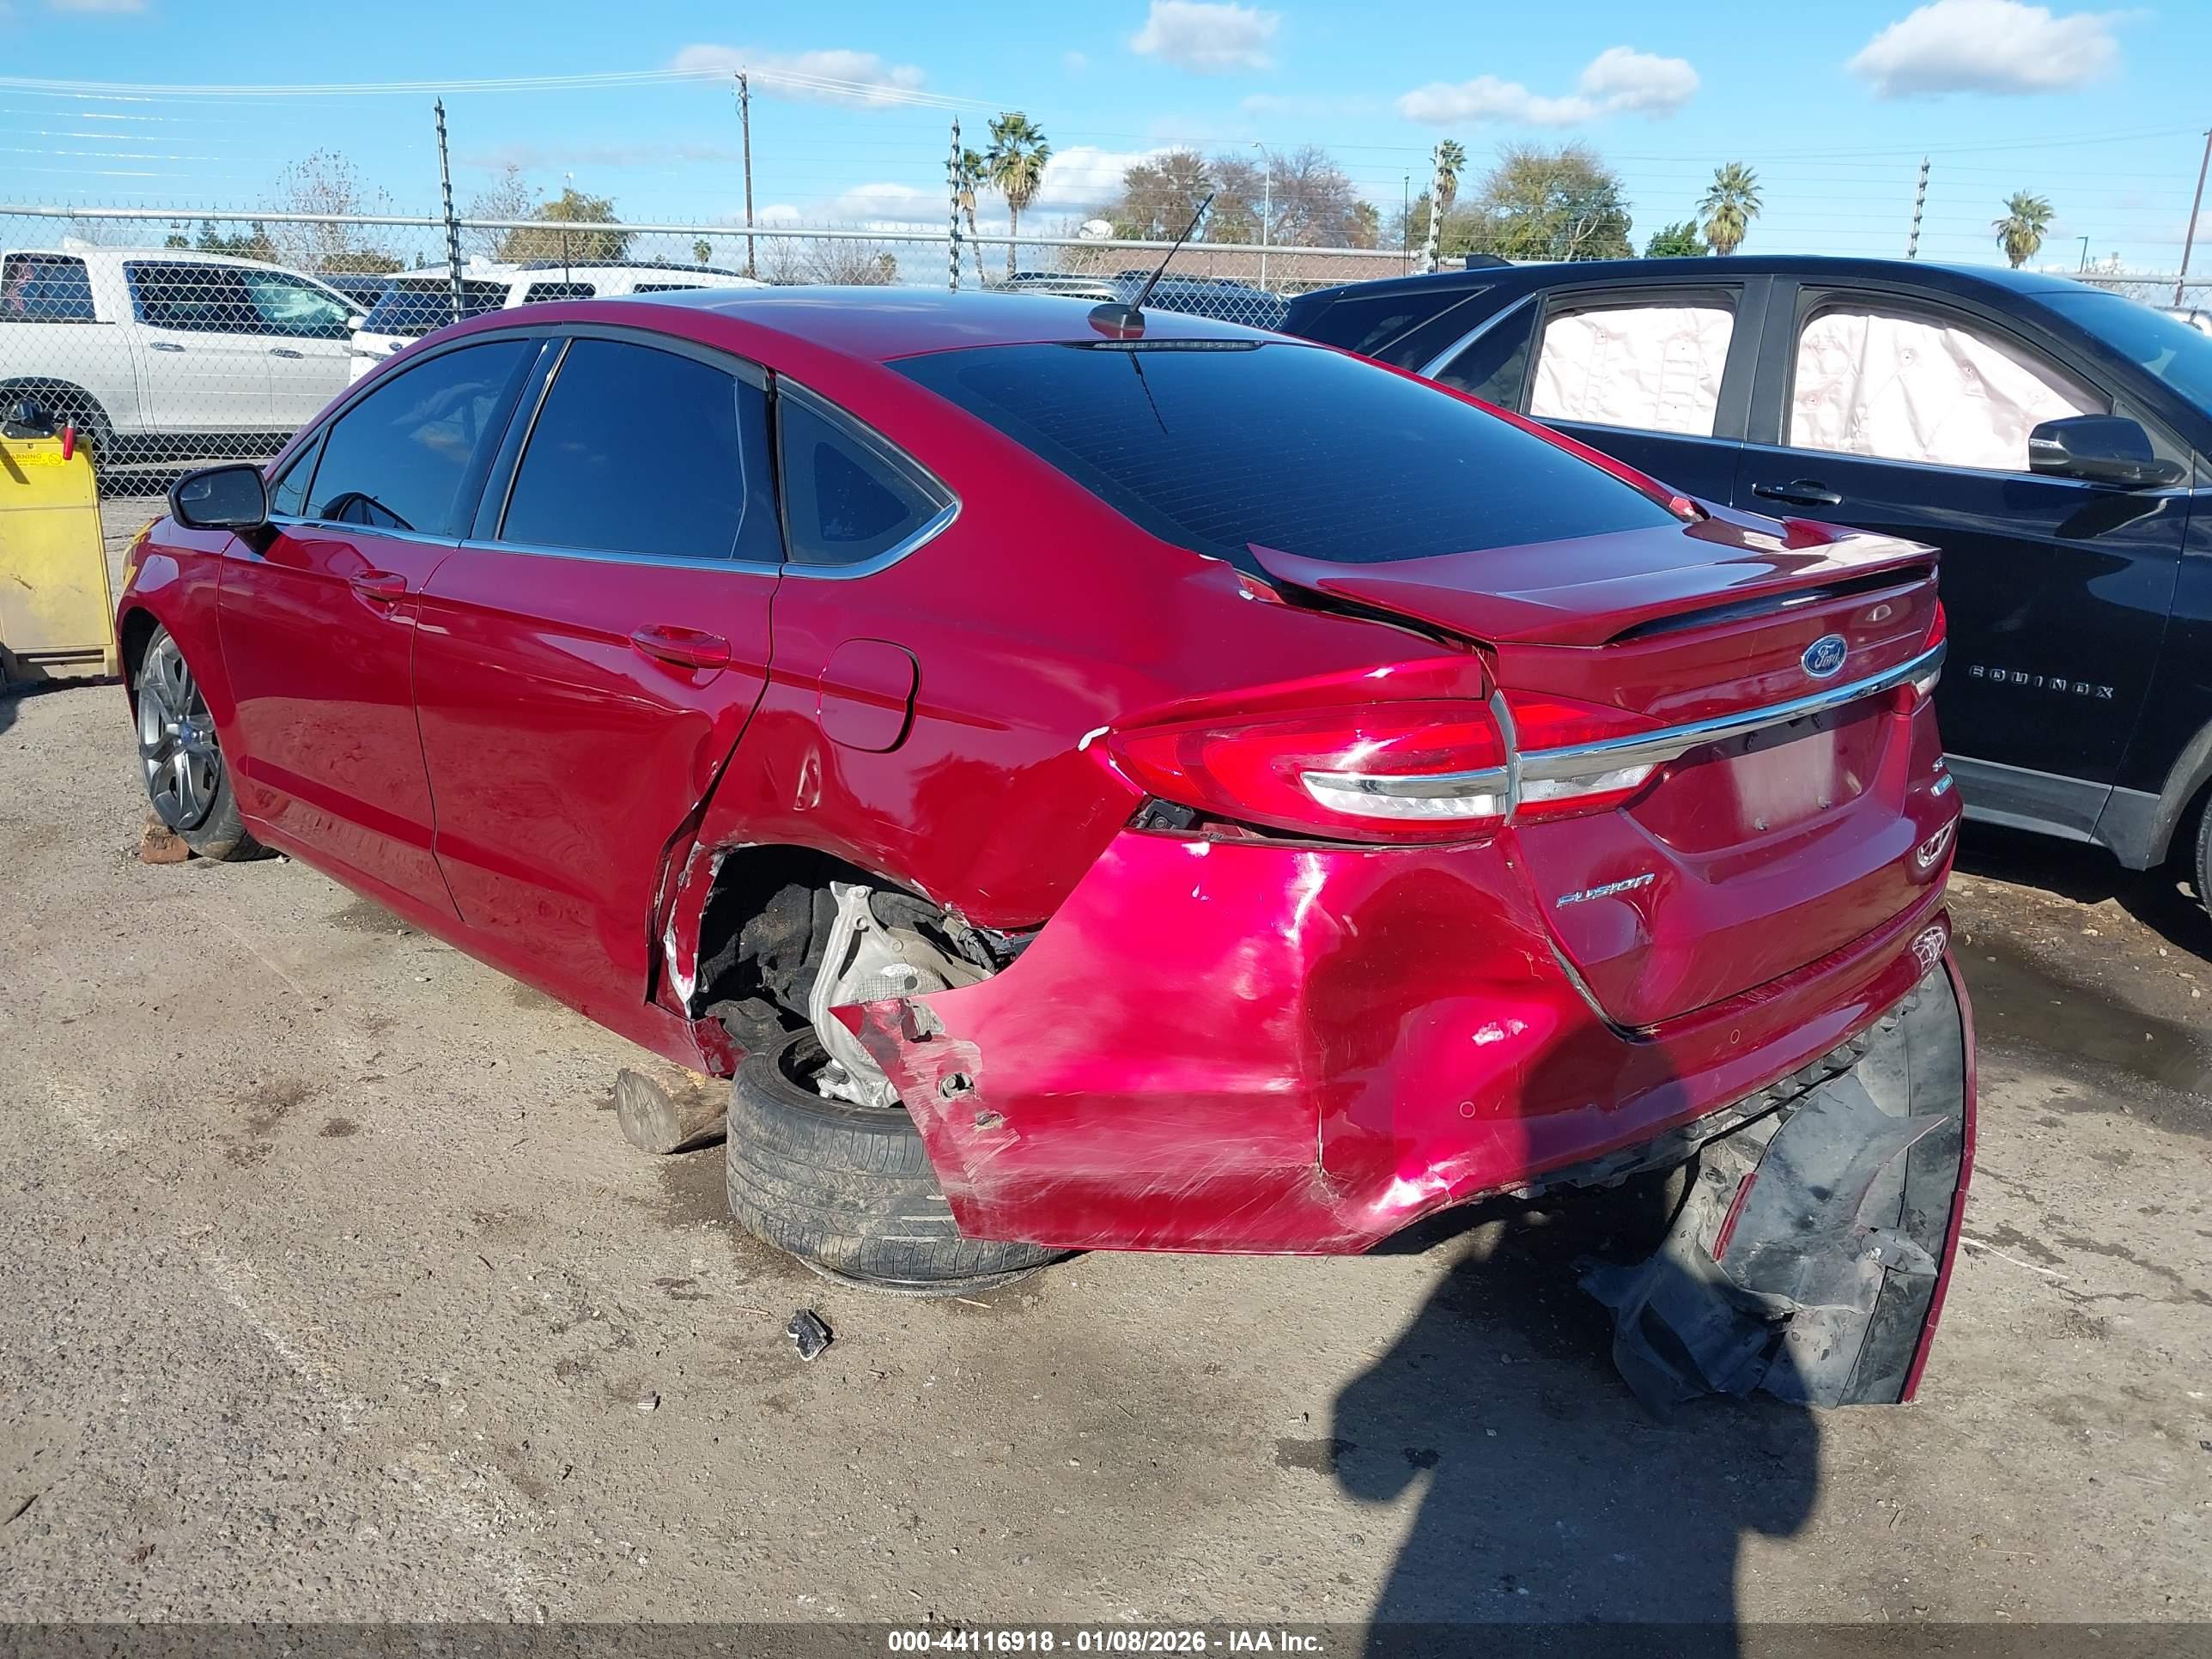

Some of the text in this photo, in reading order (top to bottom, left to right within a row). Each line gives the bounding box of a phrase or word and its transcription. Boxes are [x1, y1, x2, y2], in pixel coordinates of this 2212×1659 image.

[1814, 643, 1841, 669] Ford
[1969, 665, 2114, 699] EQUINOX
[1556, 872, 1655, 908] FUSION
